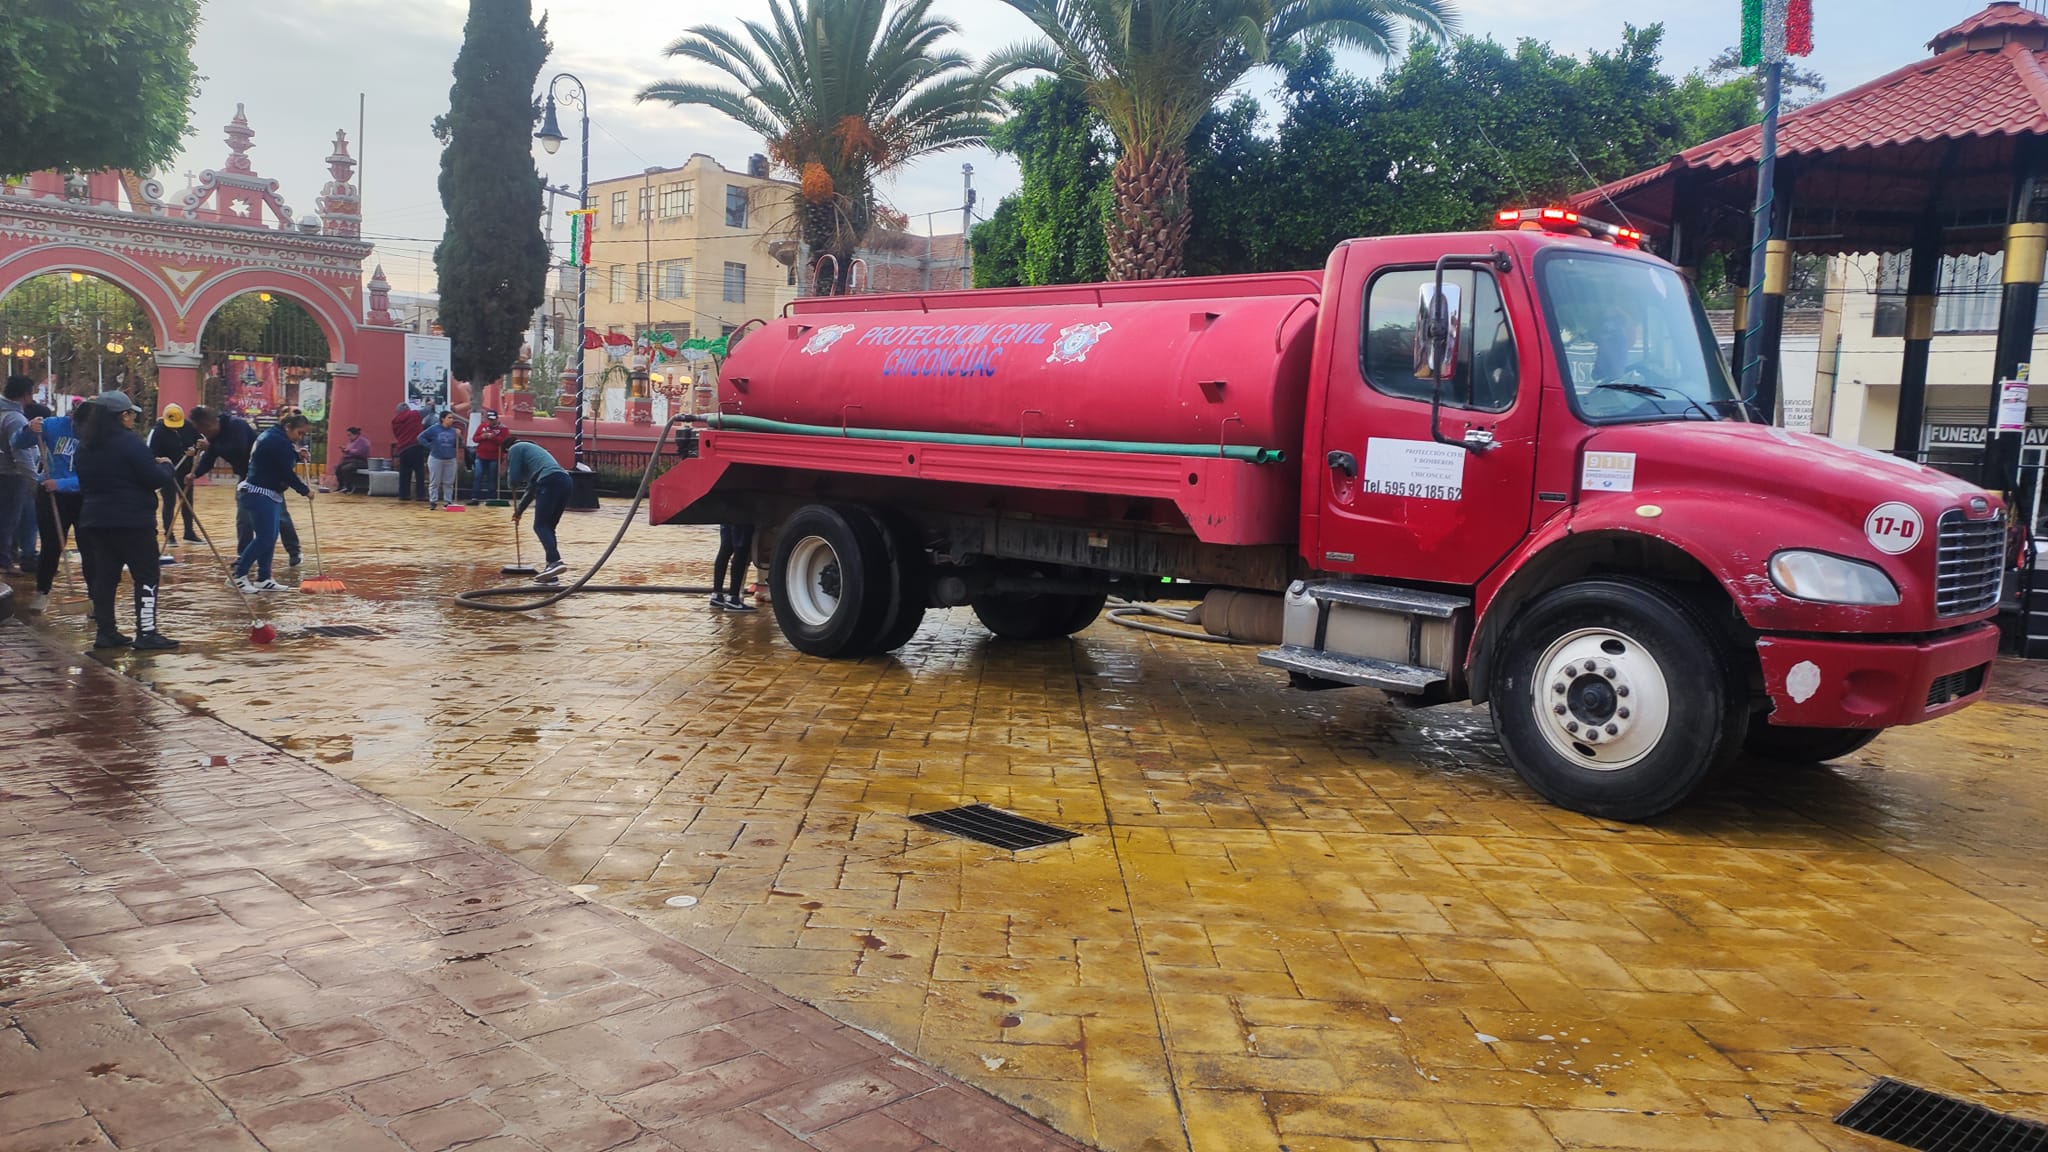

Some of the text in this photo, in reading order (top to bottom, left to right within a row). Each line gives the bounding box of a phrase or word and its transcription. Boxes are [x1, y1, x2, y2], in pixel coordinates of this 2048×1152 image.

[991, 322, 1053, 344] CIVIL
[883, 346, 1004, 377] CHICONCUAC
[1364, 480, 1462, 500] Tel. 595 92 185 62
[1874, 516, 1915, 538] 17-D
[141, 596, 156, 636] PUM
